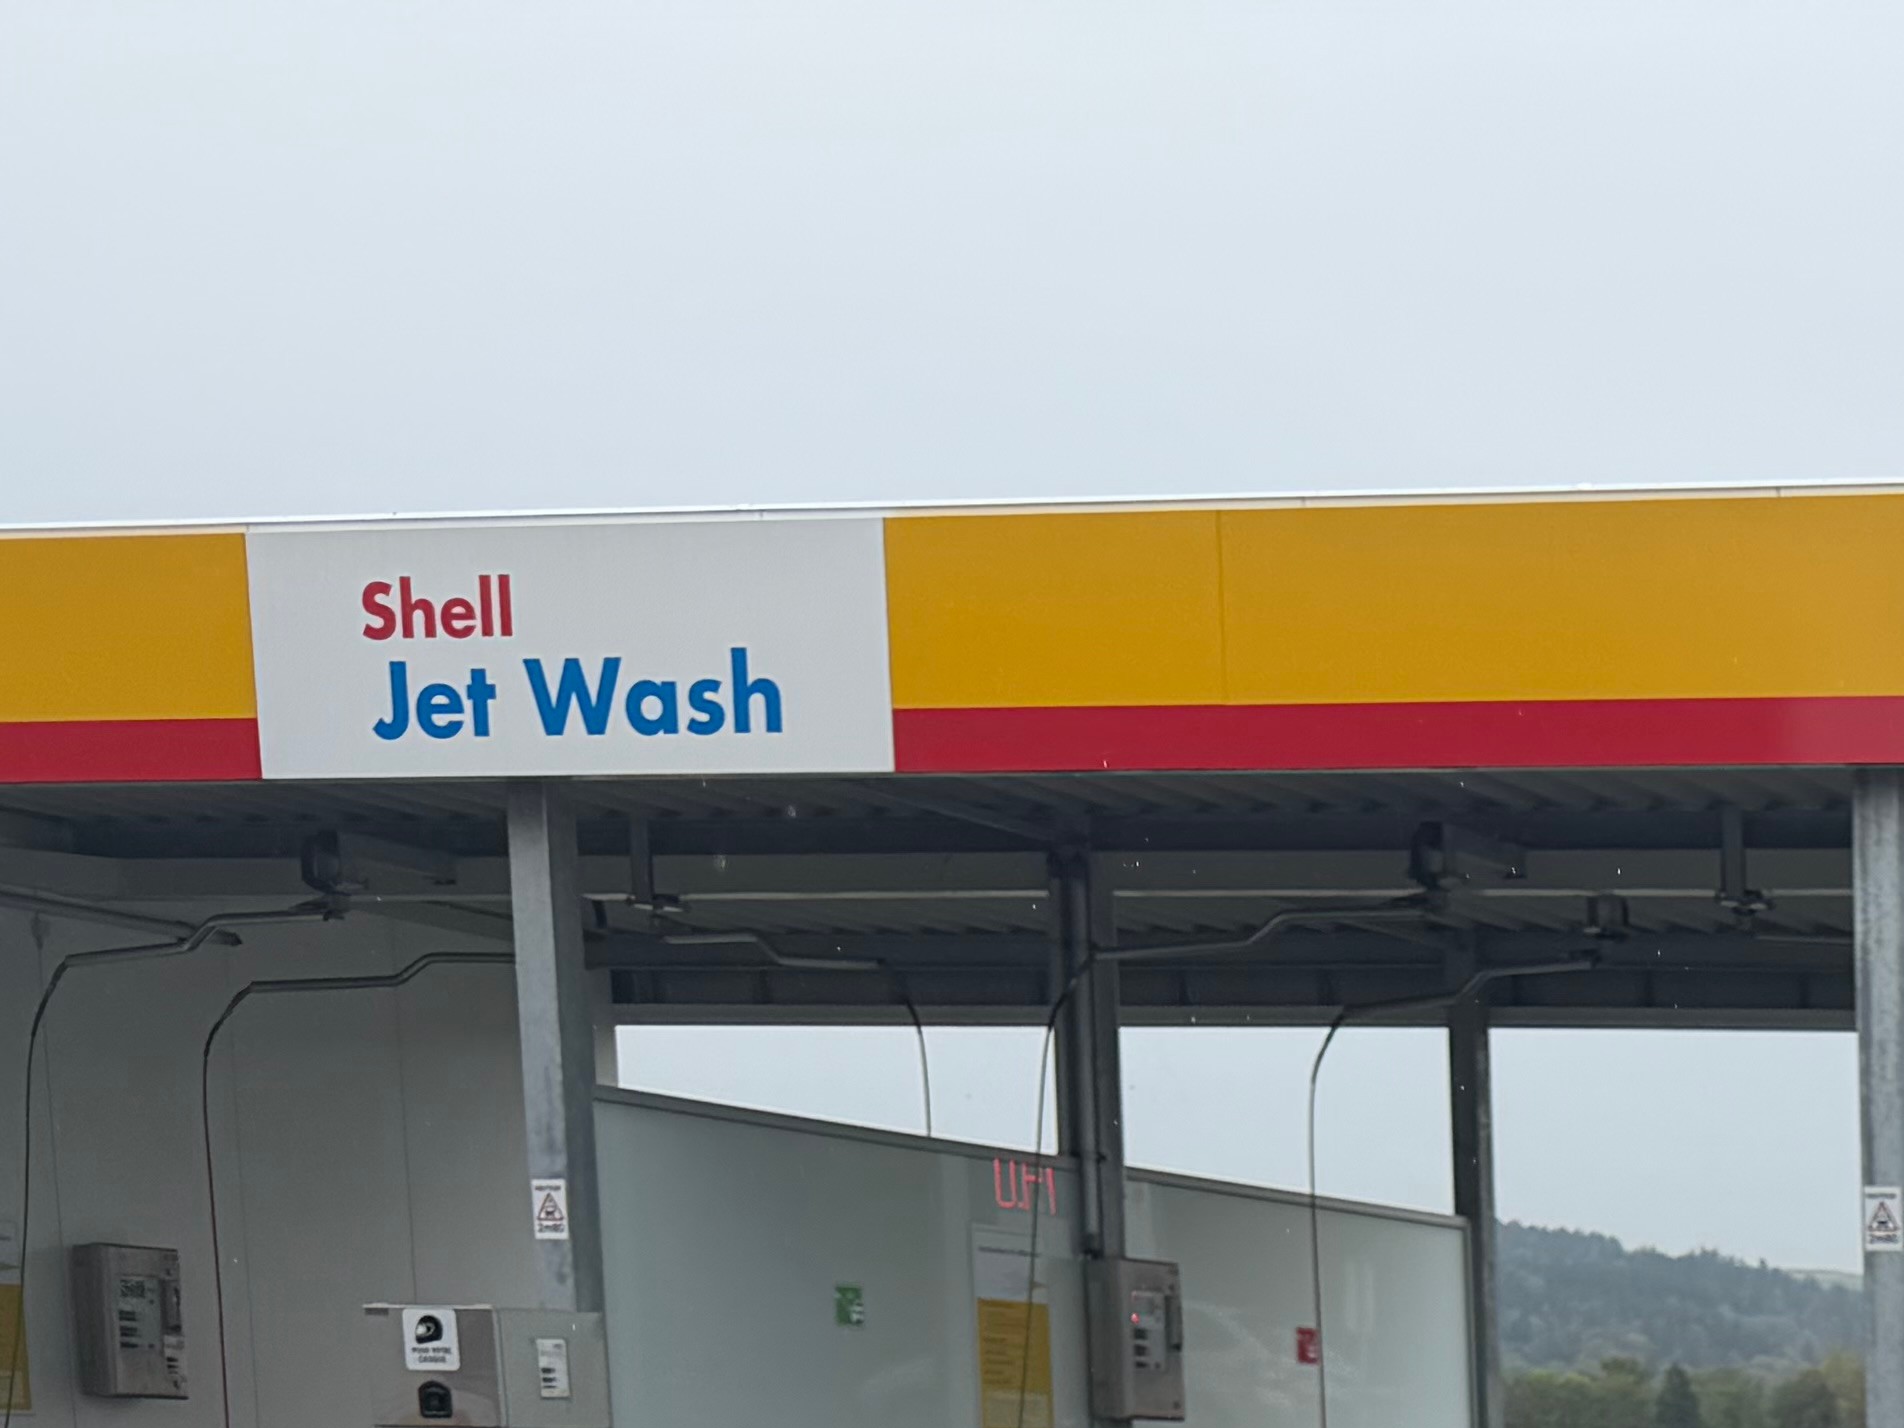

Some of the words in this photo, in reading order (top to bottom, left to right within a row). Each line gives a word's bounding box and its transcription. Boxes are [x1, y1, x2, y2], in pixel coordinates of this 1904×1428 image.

[362, 574, 513, 640] Shell
[372, 660, 497, 741] Jet
[523, 647, 783, 736] Wash
